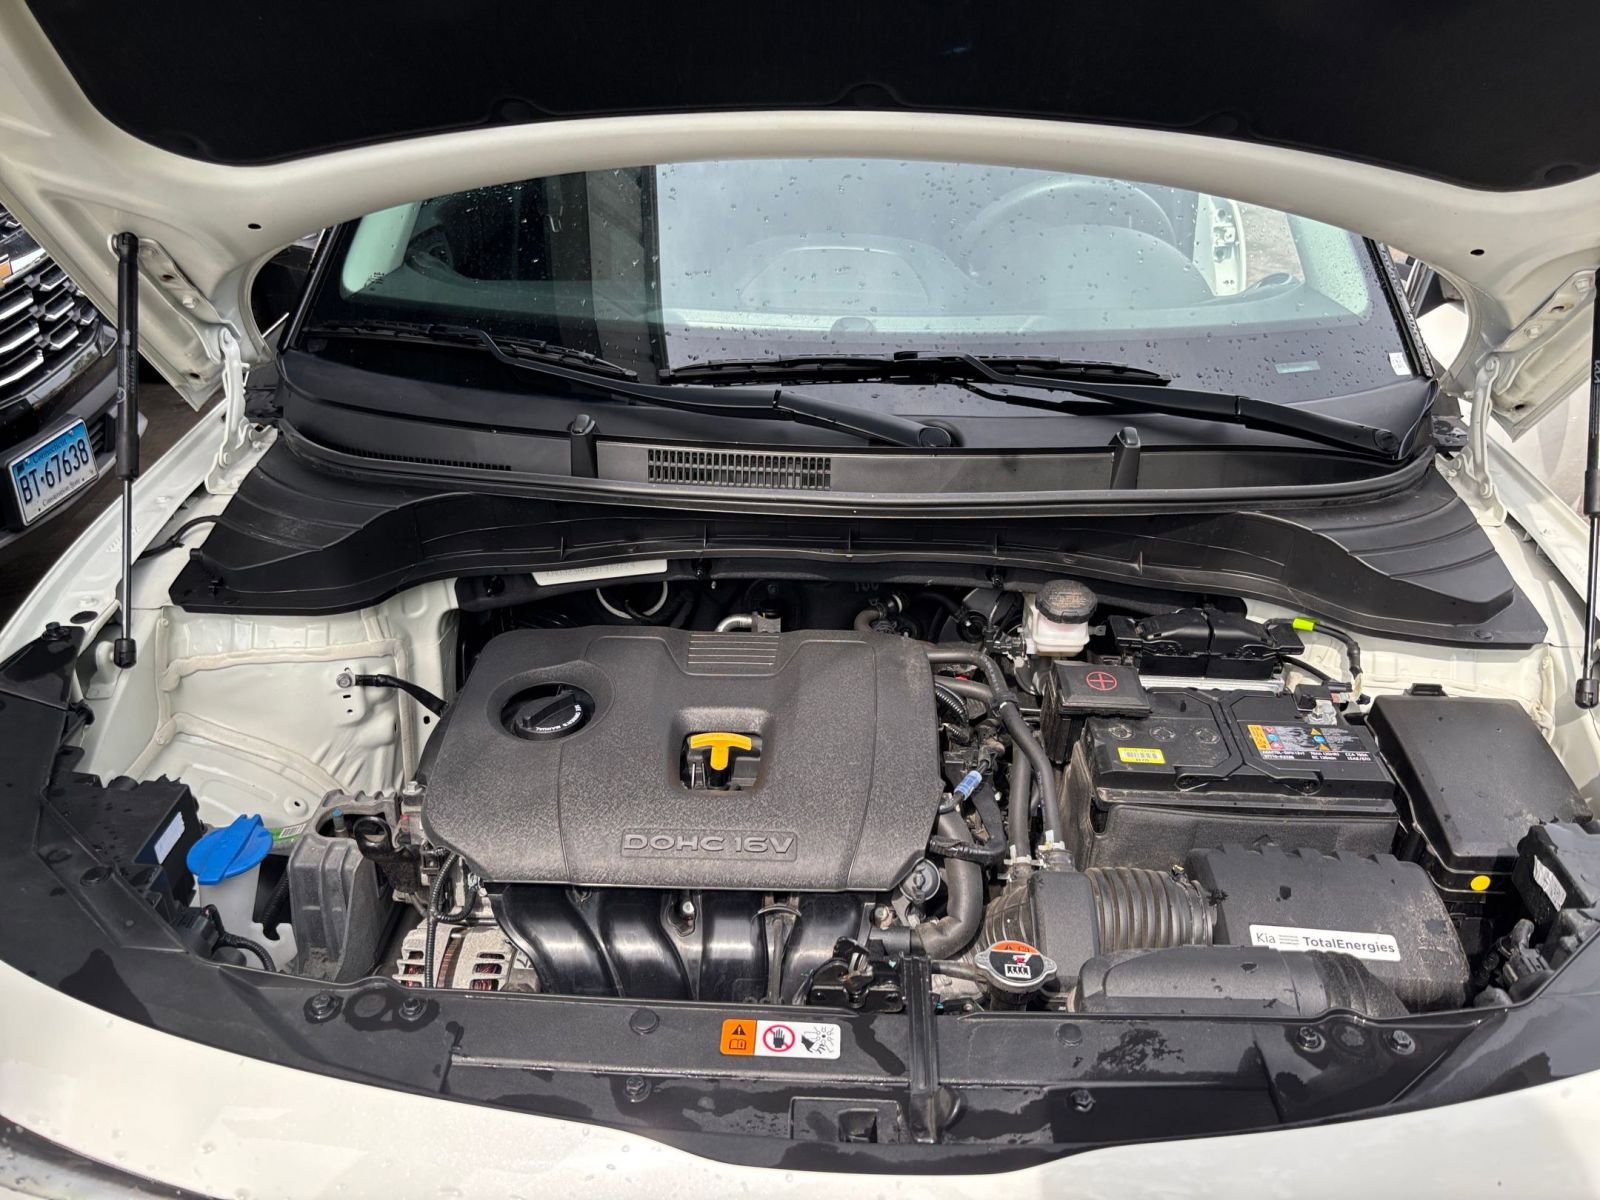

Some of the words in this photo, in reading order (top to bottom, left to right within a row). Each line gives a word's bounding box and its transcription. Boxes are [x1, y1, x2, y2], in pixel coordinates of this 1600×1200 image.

[623, 834, 725, 851] DOHC
[735, 836, 794, 854] 16V
[1256, 932, 1276, 944] Kia
[1302, 936, 1395, 953] TotalEnergies
